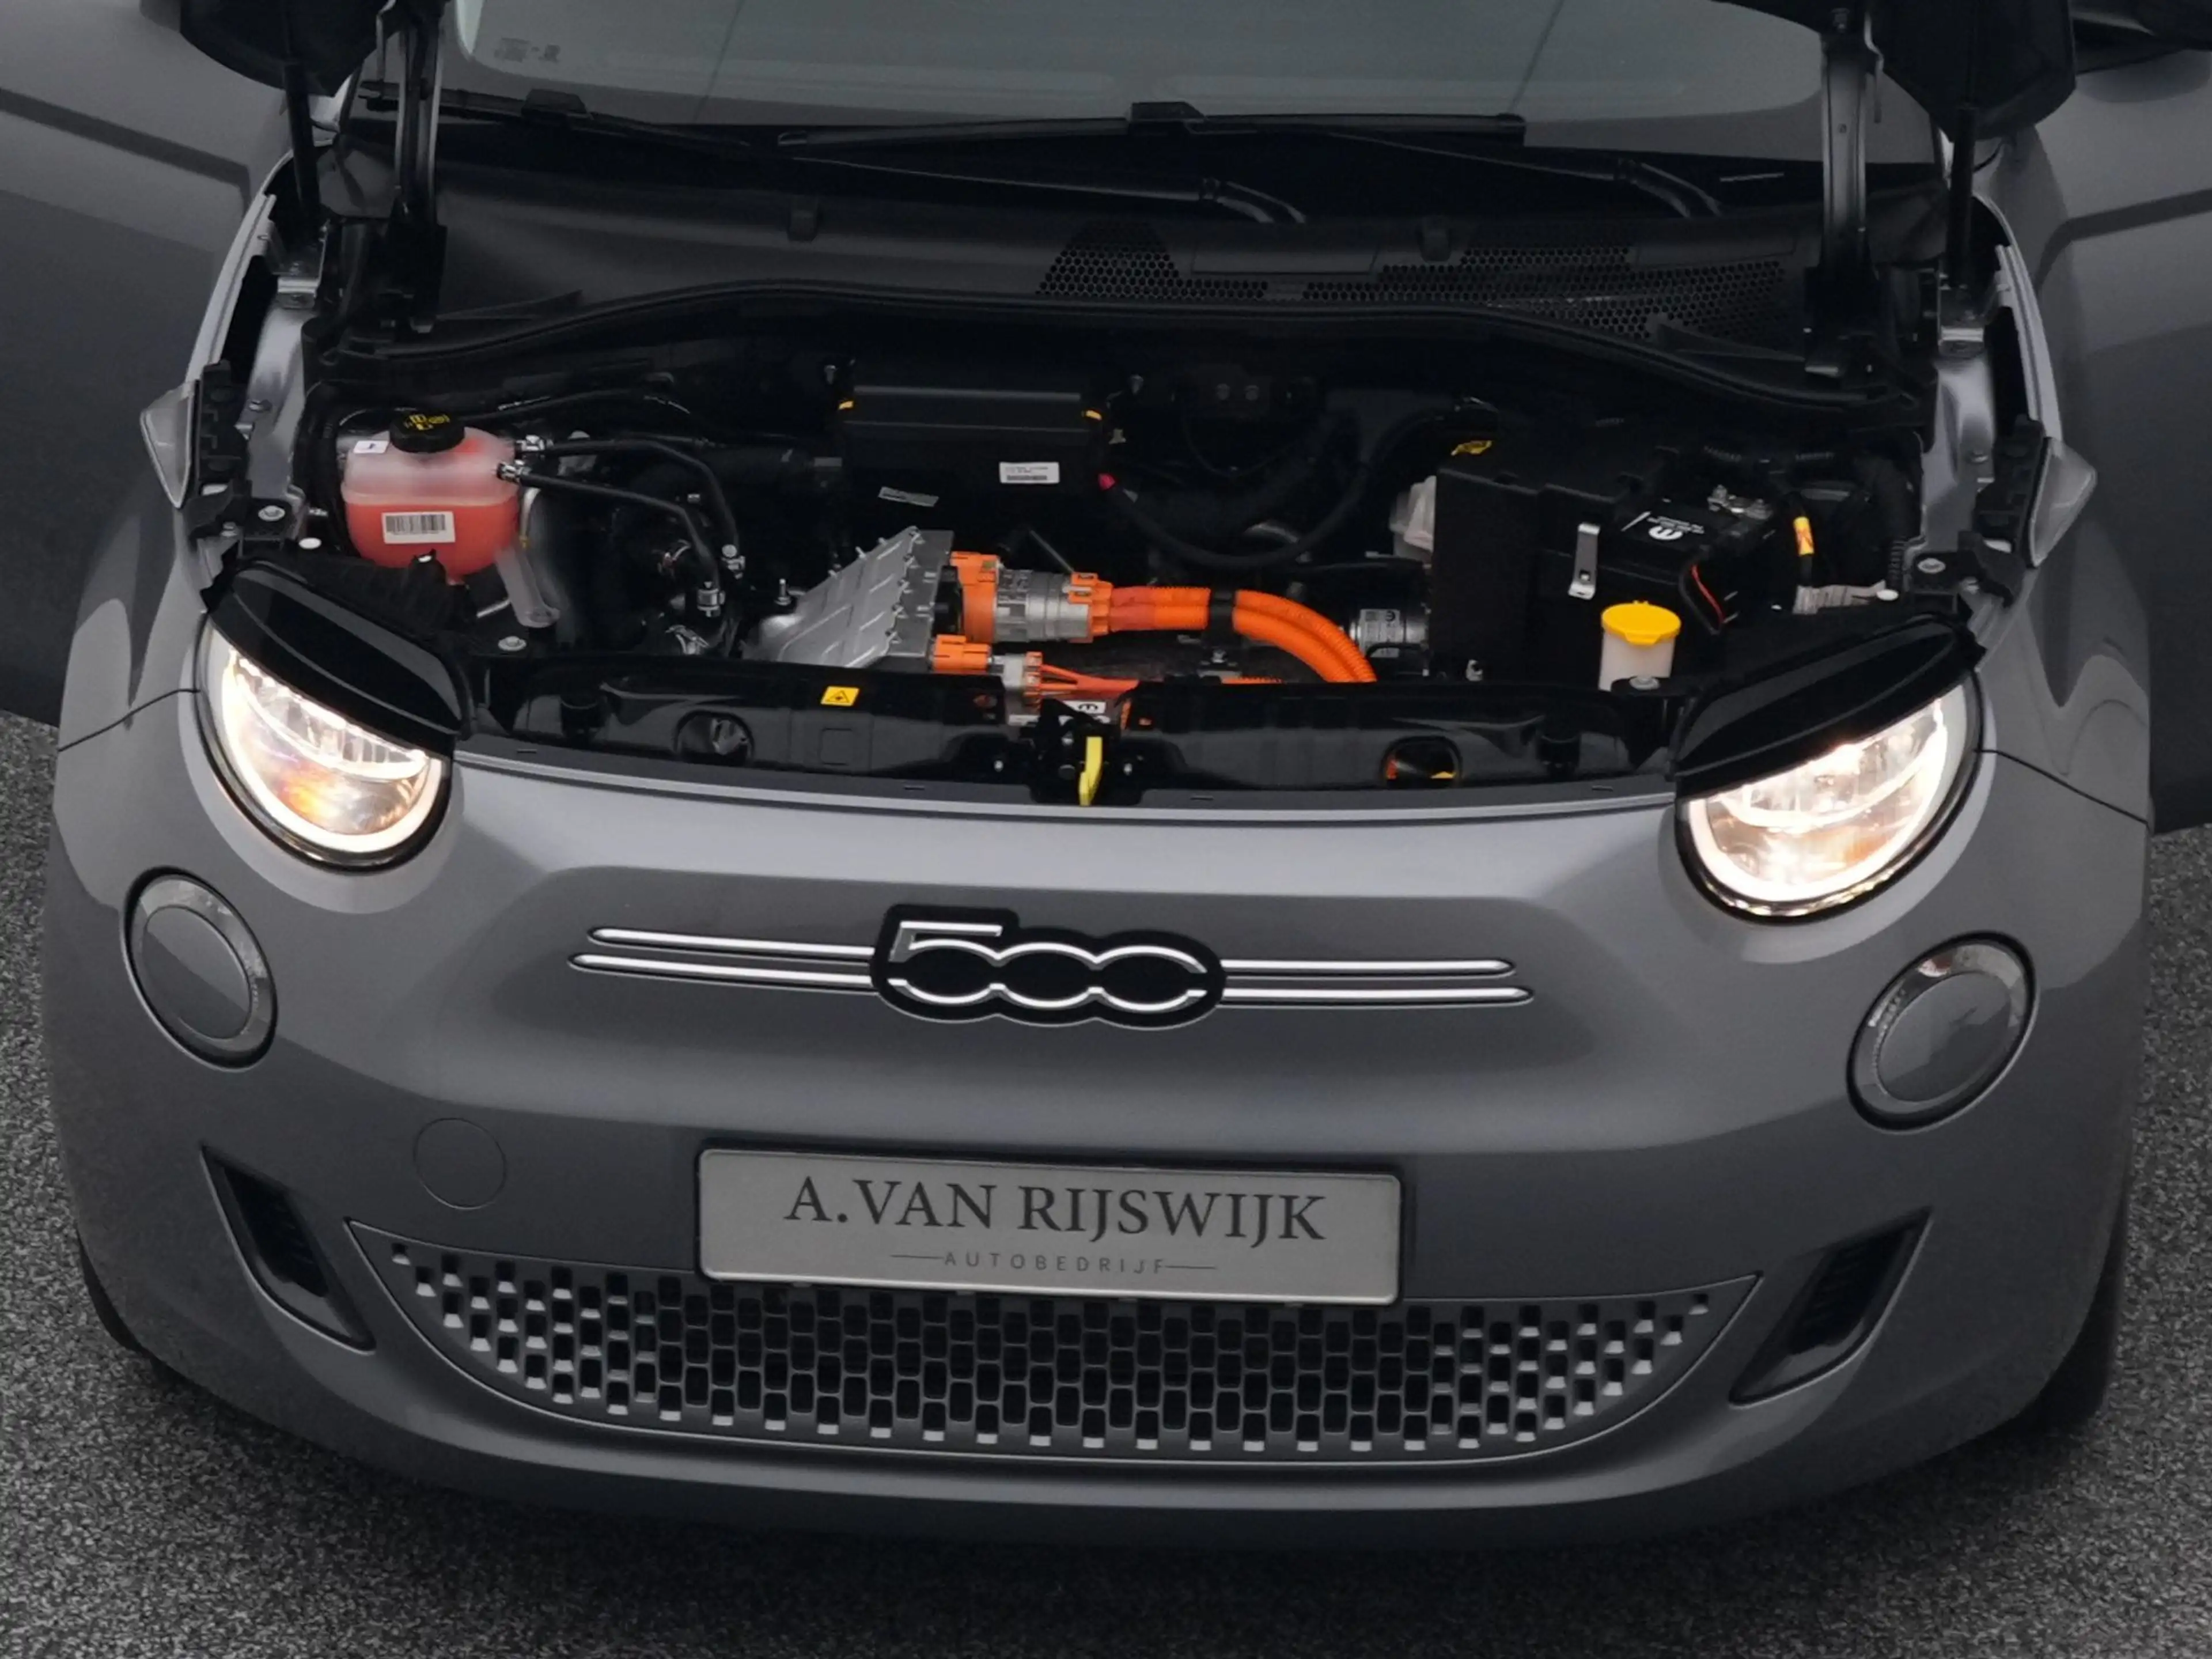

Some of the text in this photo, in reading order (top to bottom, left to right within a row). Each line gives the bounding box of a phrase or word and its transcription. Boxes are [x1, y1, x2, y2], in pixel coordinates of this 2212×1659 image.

[888, 920, 1209, 1014] 500
[1017, 1185, 1327, 1248] RIJSWIJK
[944, 1252, 1164, 1274] AUTOBEDRIJF
